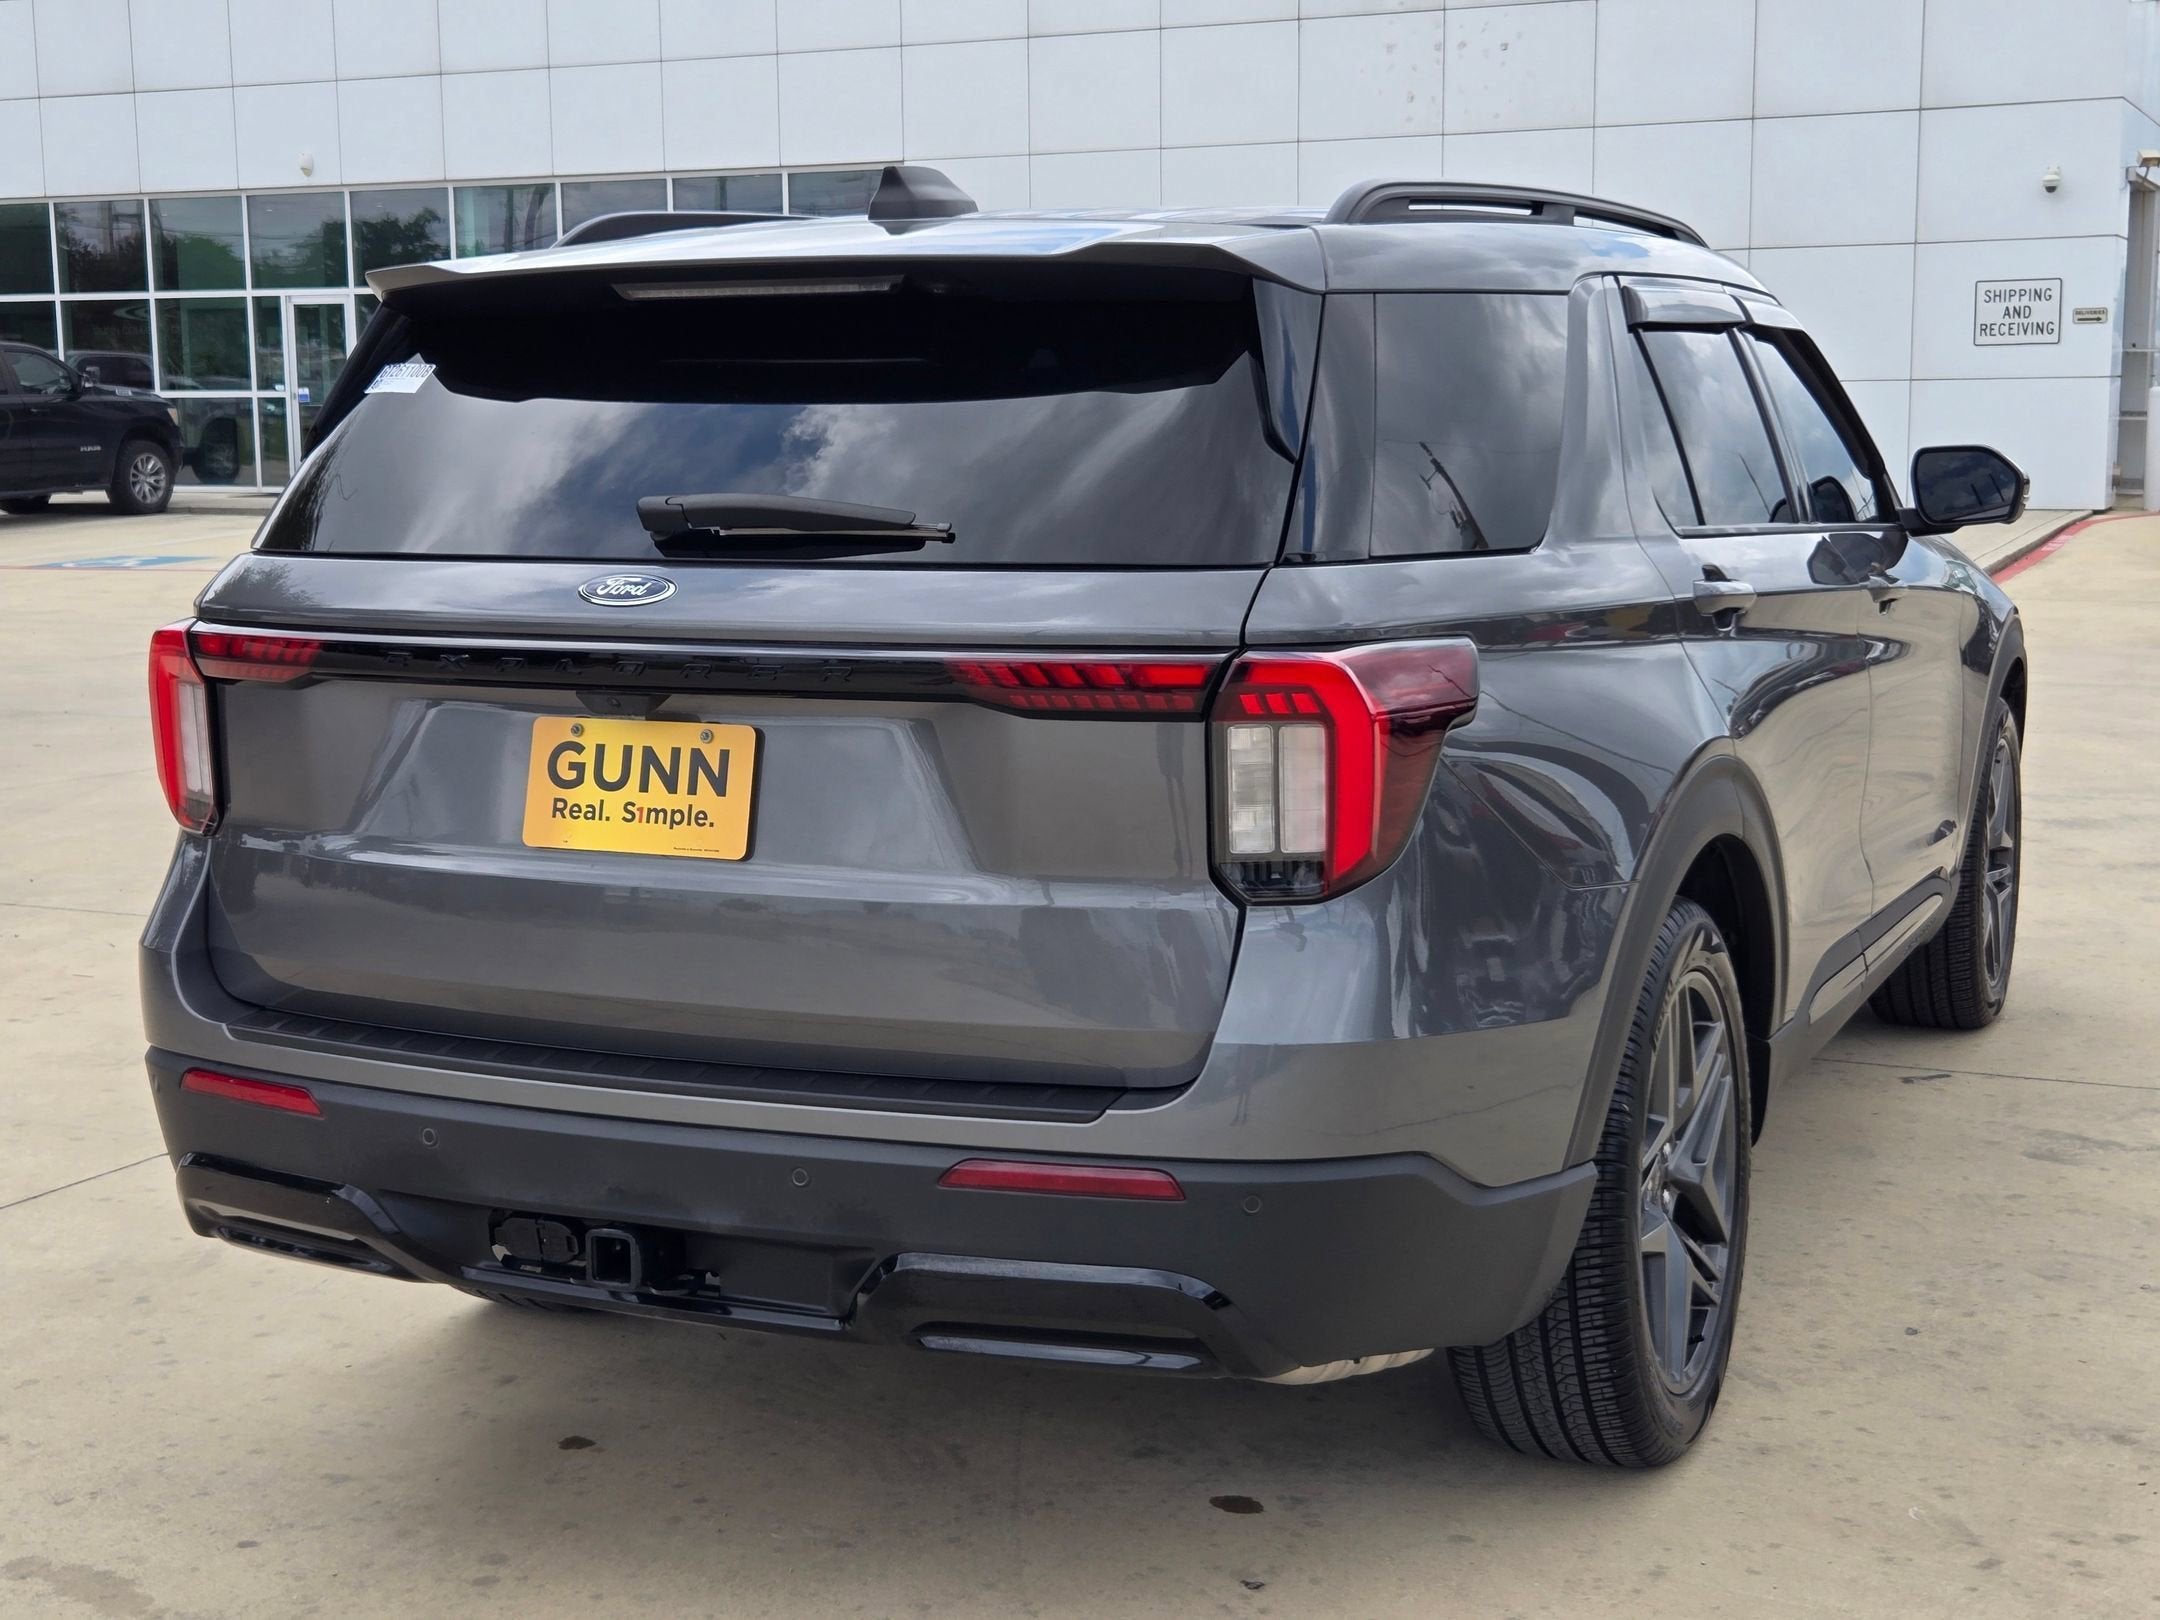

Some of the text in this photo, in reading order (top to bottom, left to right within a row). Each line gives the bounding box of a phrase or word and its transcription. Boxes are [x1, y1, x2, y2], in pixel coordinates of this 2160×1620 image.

[1984, 288, 2052, 303] SHIPPING
[2003, 305, 2032, 319] AND
[1980, 321, 2054, 337] RECEIVING
[597, 577, 652, 595] Ford
[547, 740, 730, 797] GUNN
[552, 797, 610, 821] Real.
